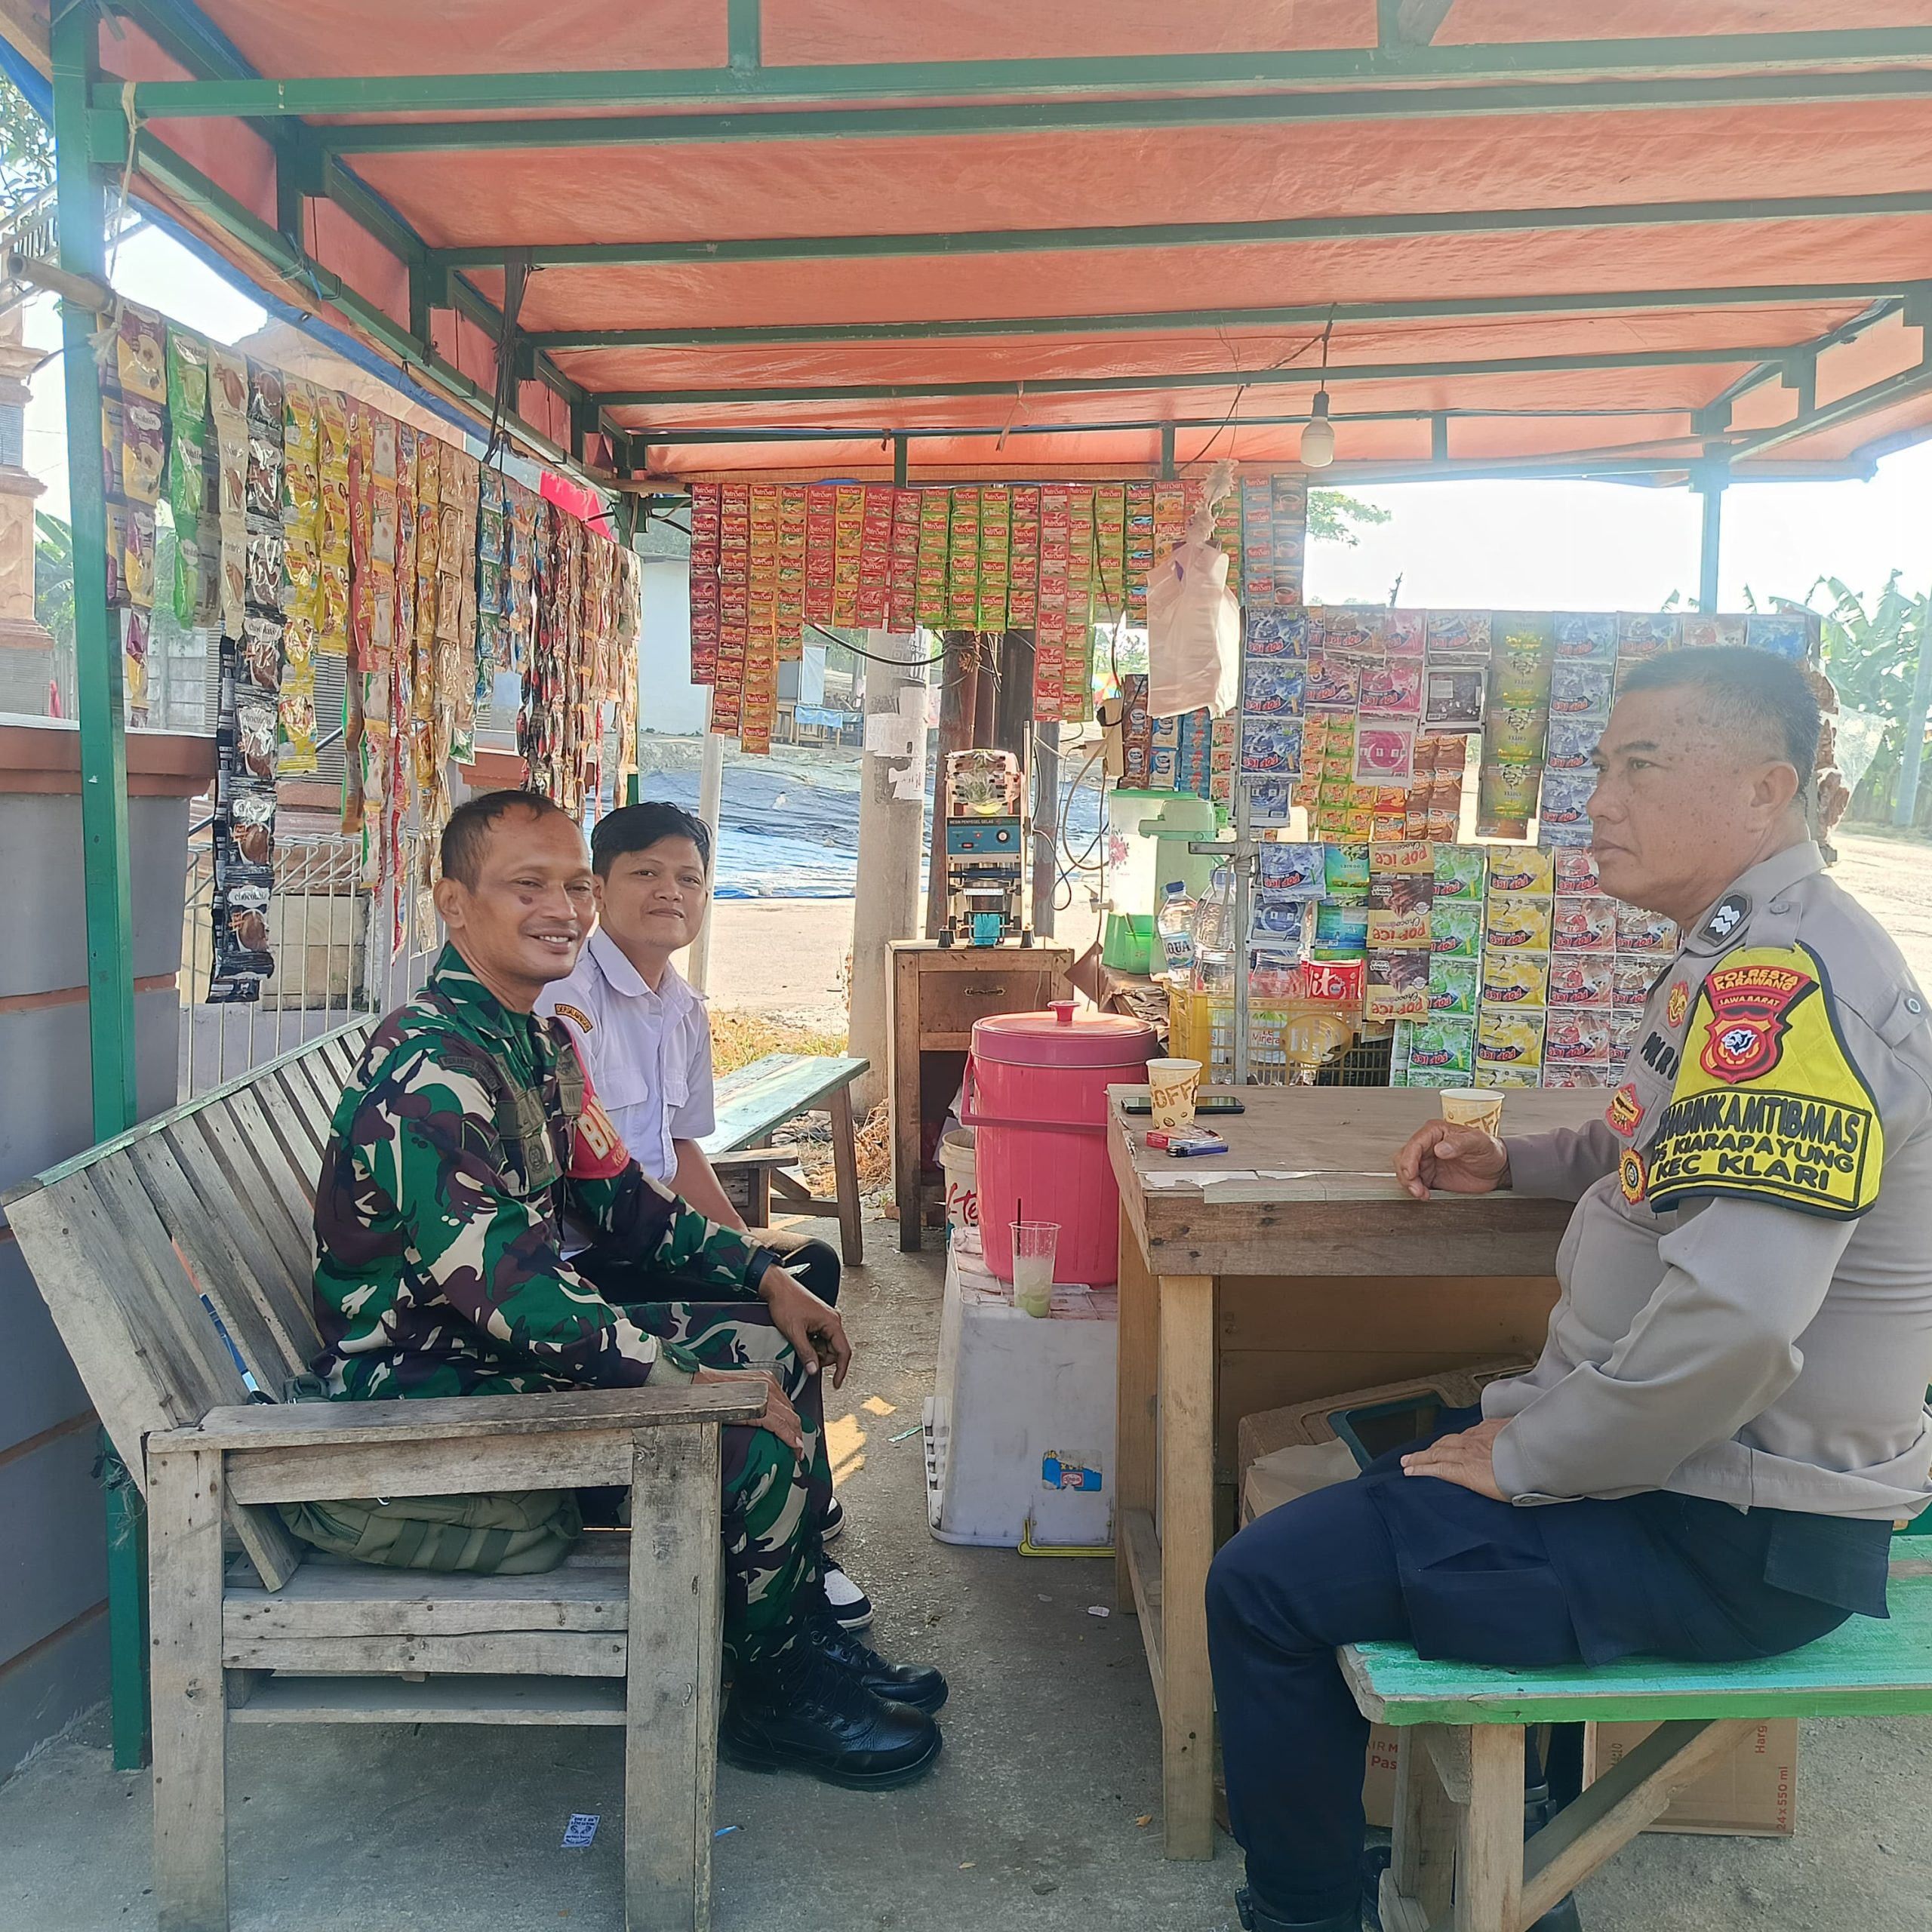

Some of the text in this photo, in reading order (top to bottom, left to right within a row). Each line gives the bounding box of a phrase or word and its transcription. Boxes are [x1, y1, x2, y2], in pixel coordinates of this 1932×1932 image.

[1401, 845, 1428, 866] POP
[1400, 923, 1426, 941] POP
[1712, 968, 1798, 986] POLRESTA
[1715, 977, 1793, 991] KARAWANG
[1398, 997, 1424, 1015] POP
[1718, 995, 1780, 1006] JAWA BARAT
[1252, 1032, 1285, 1045] Minera
[1672, 1134, 1854, 1174] KIARAPAYUNG
[1656, 1152, 1829, 1191] KEC KLARI
[1755, 1724, 1767, 1754] Harg
[1778, 1766, 1789, 1780] ml
[1777, 1783, 1788, 1806] 550
[1776, 1817, 1786, 1830] 24
